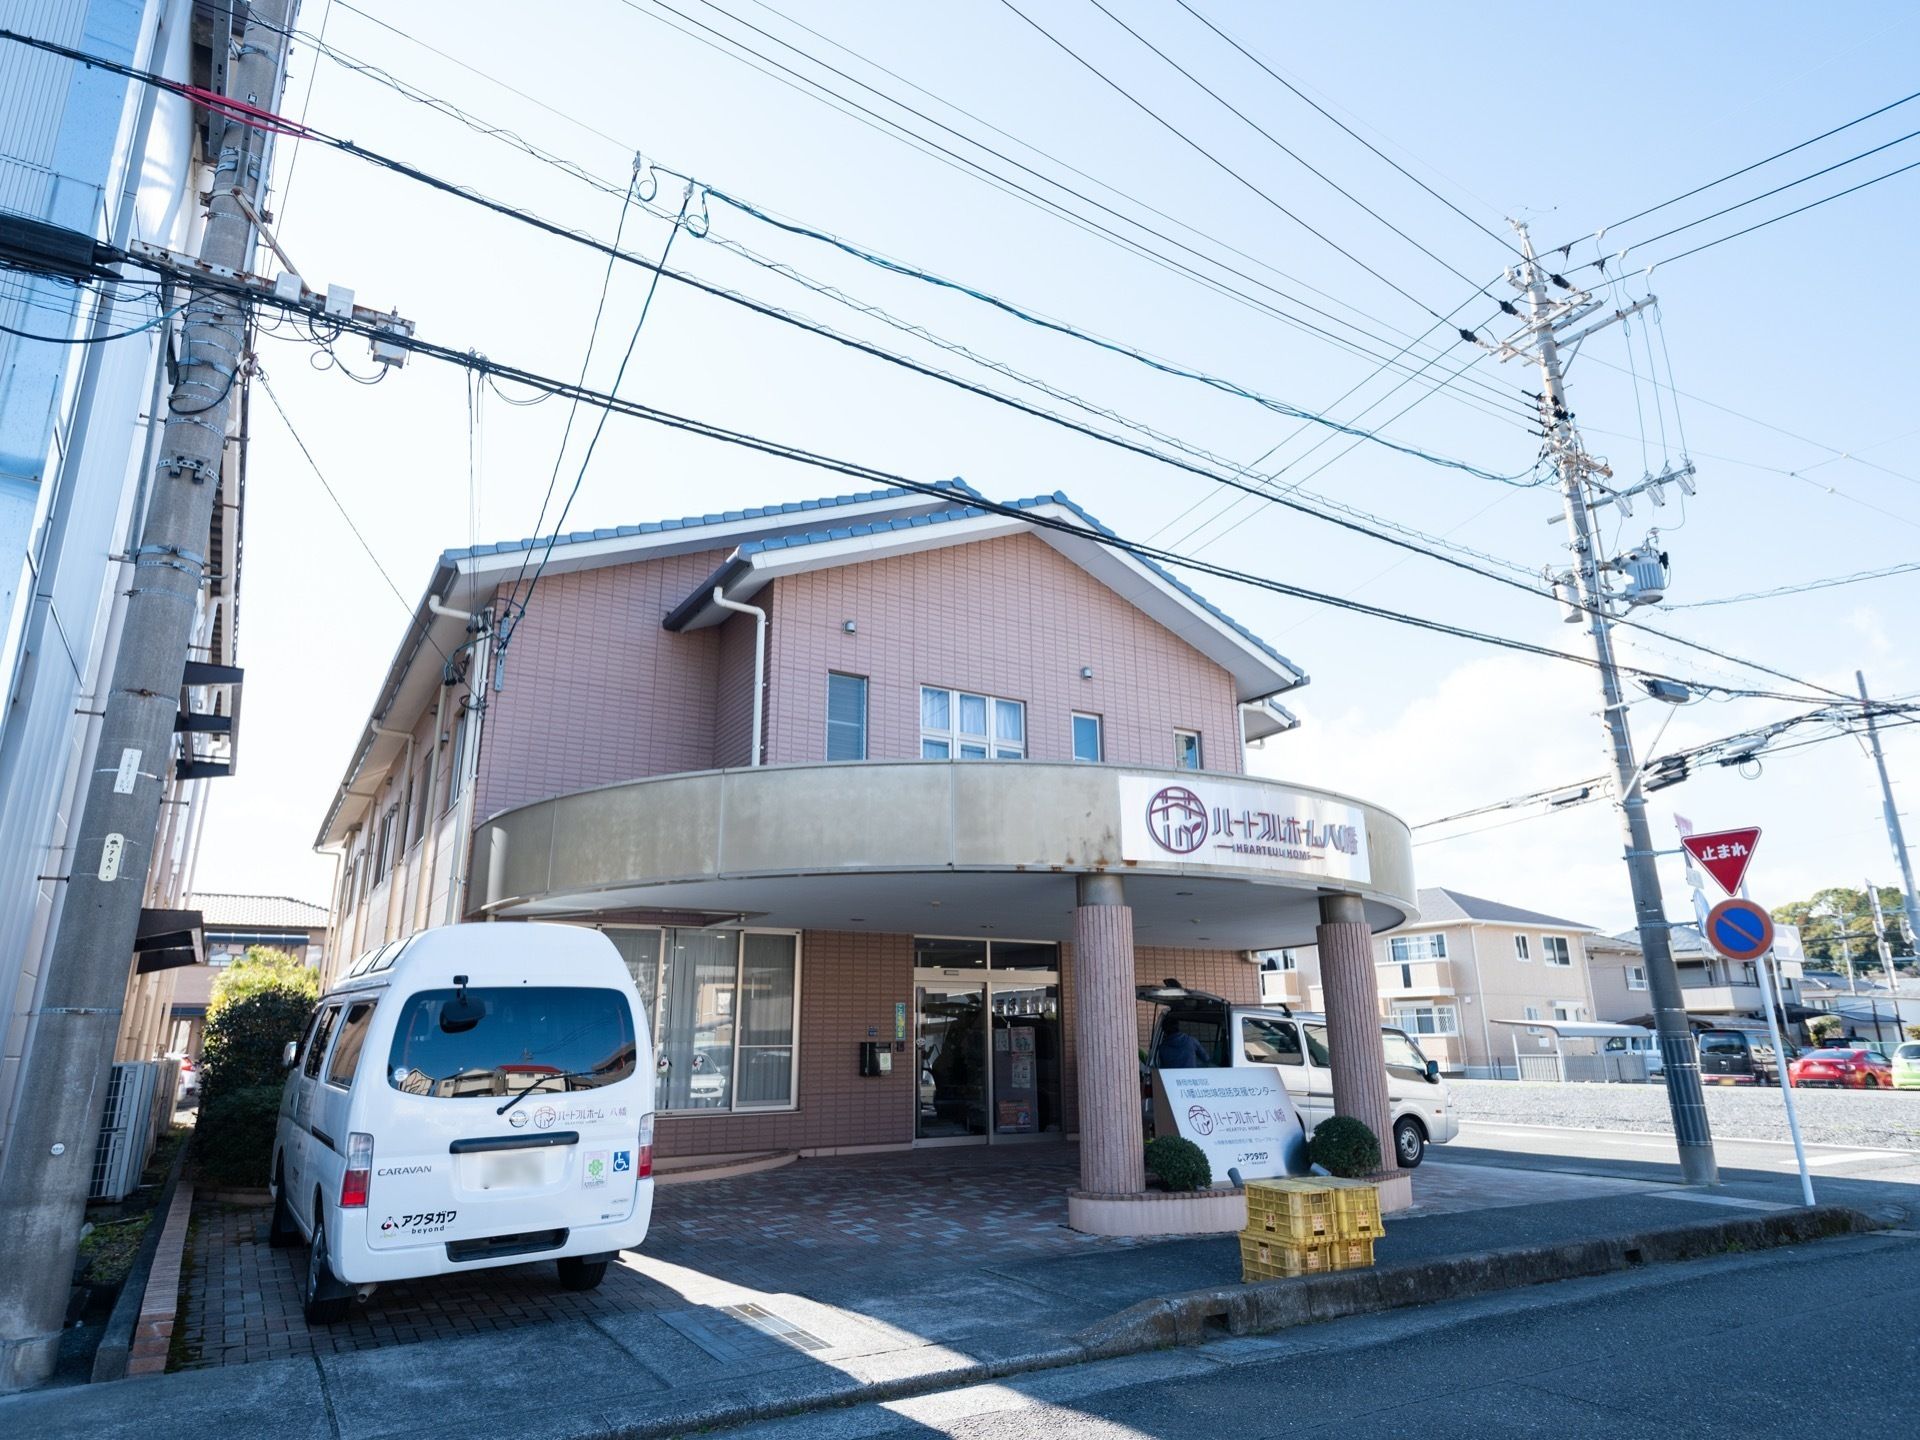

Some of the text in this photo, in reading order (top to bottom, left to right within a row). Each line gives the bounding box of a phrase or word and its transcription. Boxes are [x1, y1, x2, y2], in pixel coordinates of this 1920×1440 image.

[1701, 842, 1748, 861] 止まれ
[377, 1165, 432, 1177] CARAVAN
[401, 1210, 457, 1227] アクタガワ
[411, 1225, 445, 1235] beyond
